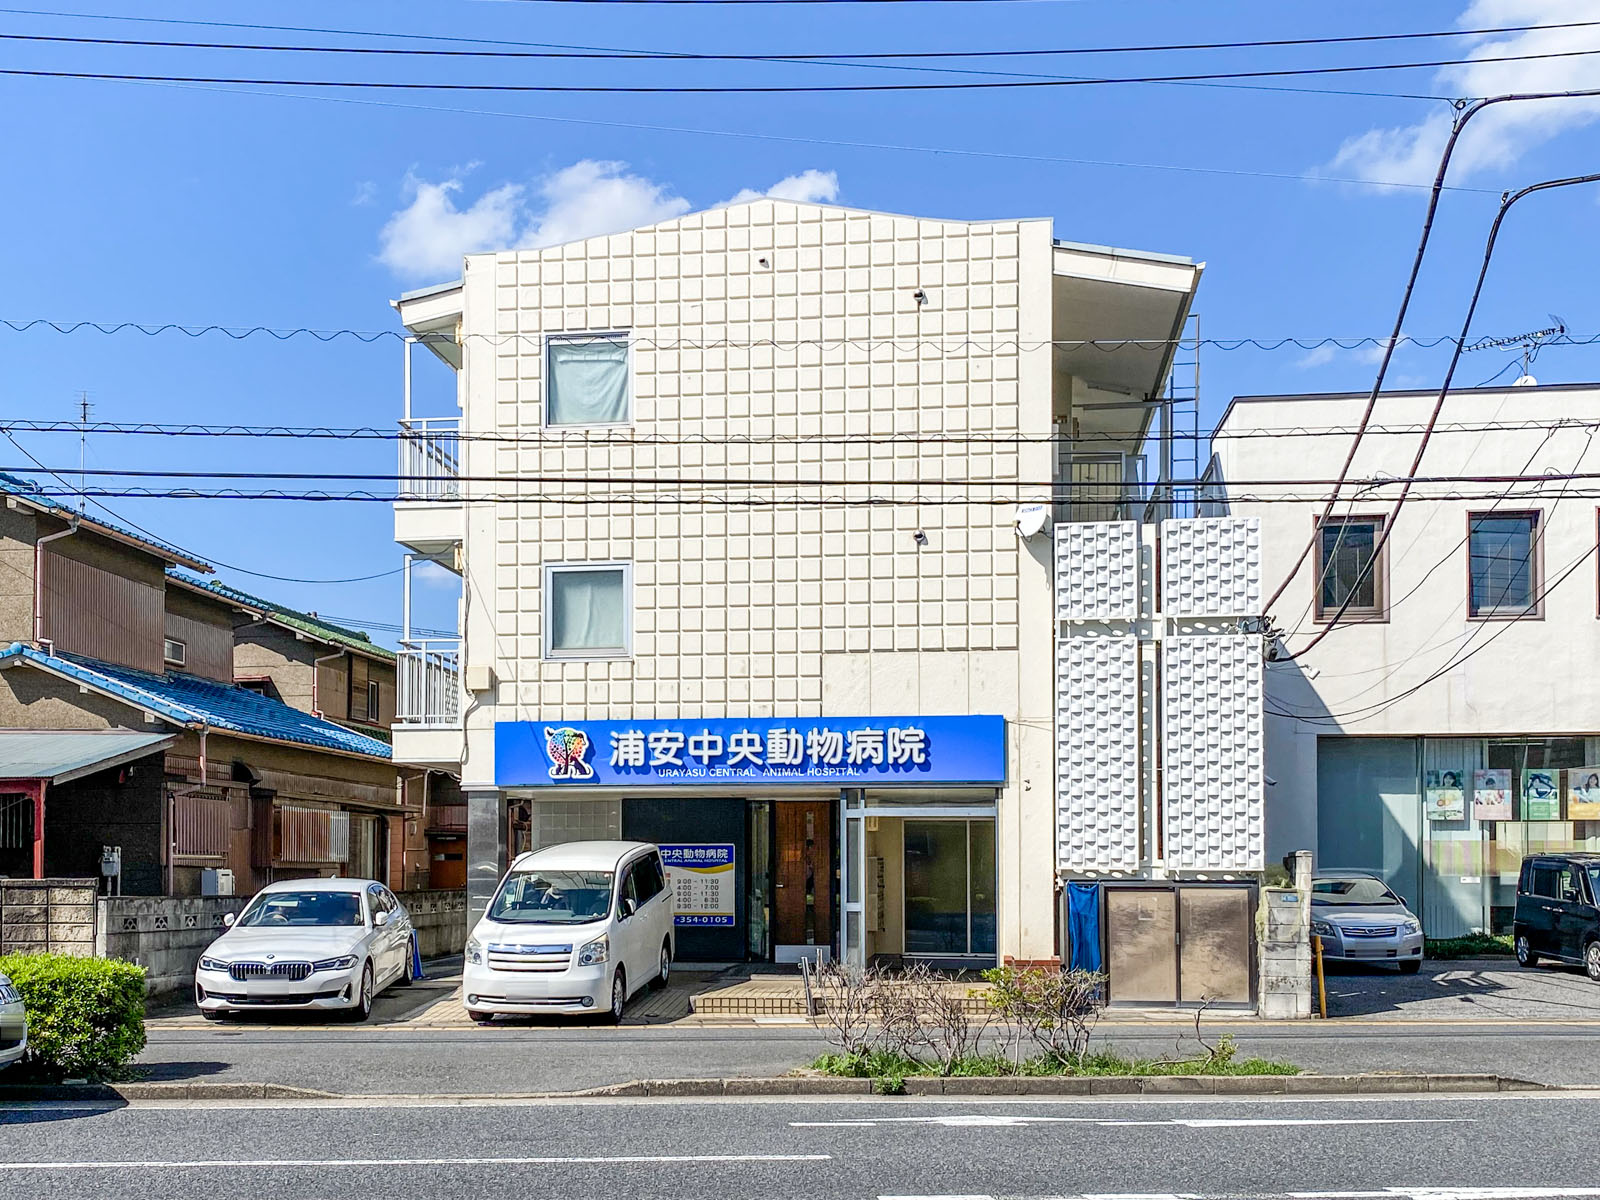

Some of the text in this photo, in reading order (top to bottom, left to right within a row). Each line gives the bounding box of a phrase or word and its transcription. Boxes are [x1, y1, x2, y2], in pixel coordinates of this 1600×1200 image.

[609, 726, 926, 767] 浦安中央動物病院
[658, 767, 861, 777] URAYASU CENTRAL ANIMAL HOSPITAL
[660, 849, 728, 858] 中央動物病院
